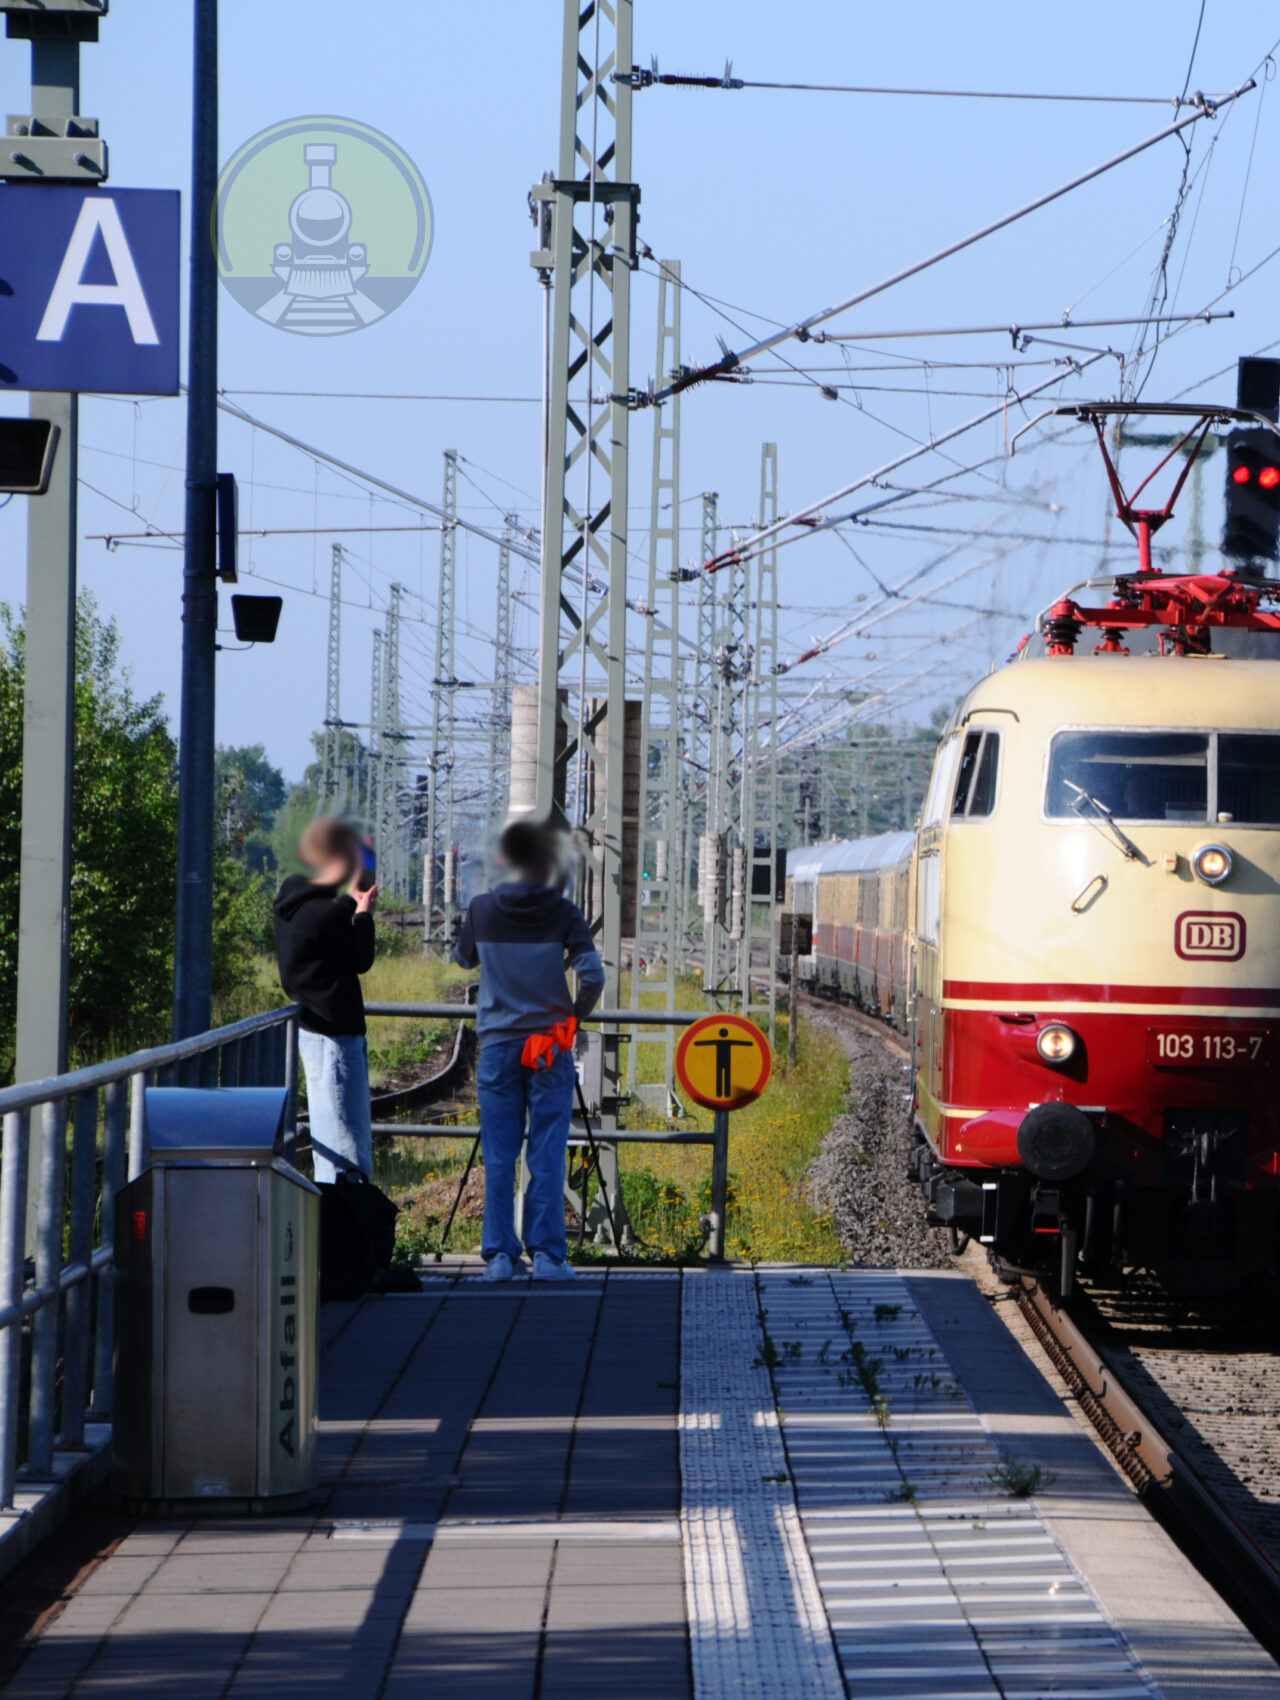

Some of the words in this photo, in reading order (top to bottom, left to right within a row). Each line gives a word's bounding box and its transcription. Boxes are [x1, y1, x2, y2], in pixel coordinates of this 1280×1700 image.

[36, 196, 160, 345] A
[1189, 924, 1232, 948] DB
[1157, 1033, 1194, 1058] 103
[1203, 1036, 1262, 1060] 113-7
[279, 1275, 296, 1458] Abfall
